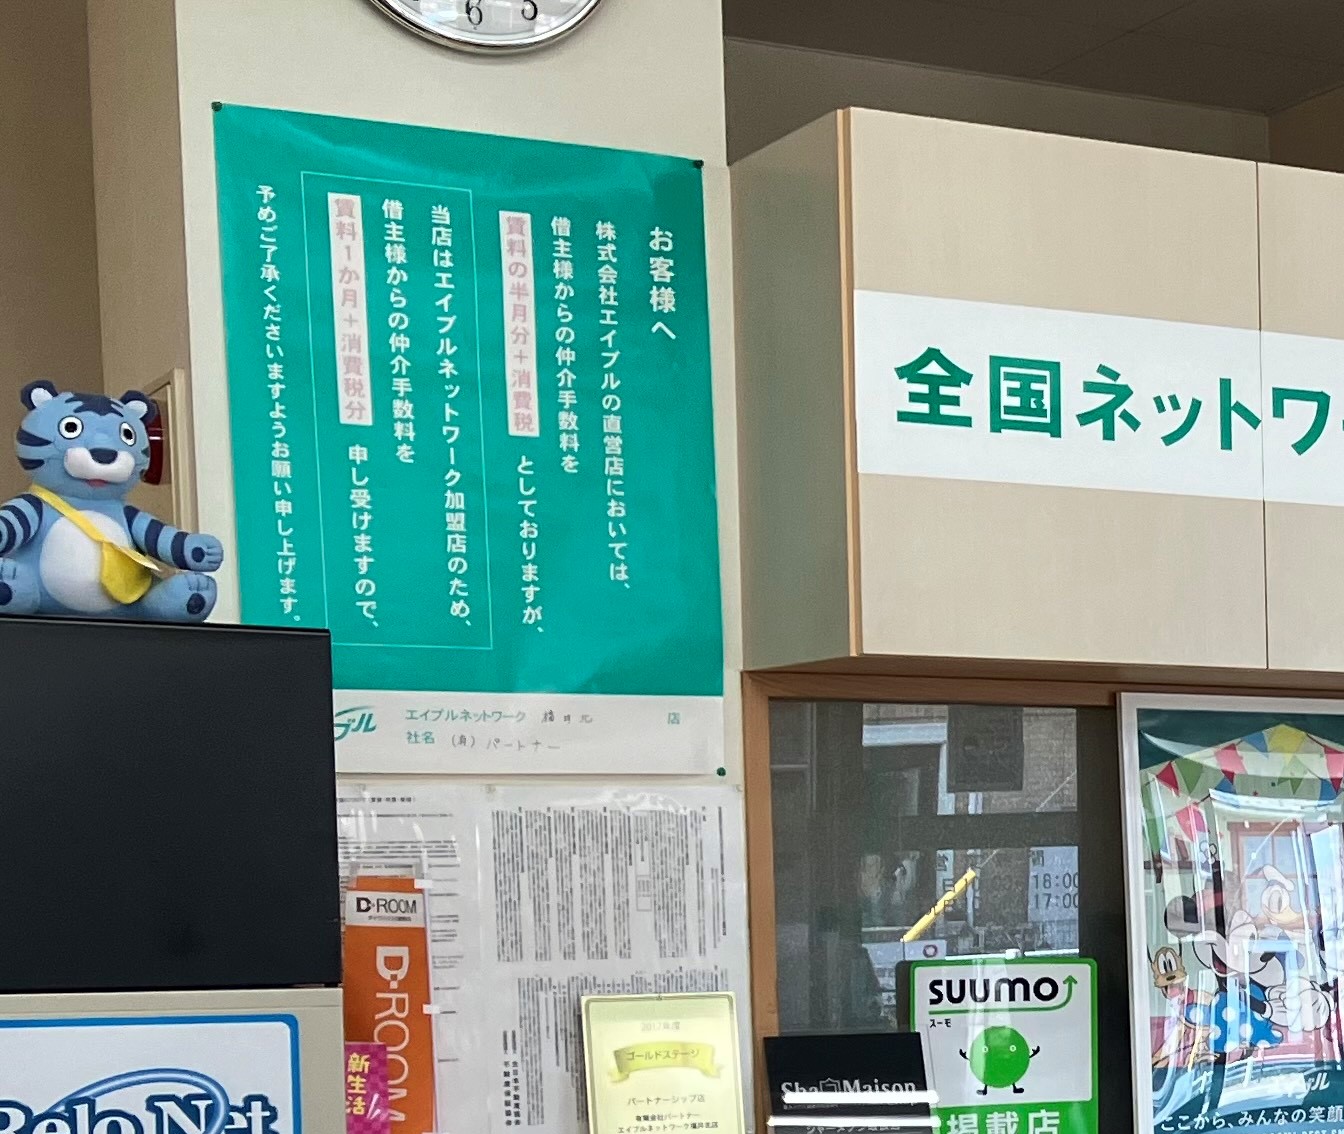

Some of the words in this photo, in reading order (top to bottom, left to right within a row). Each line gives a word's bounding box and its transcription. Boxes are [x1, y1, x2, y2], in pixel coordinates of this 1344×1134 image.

[382, 198, 415, 464] 借主様からの仲介手数料を
[550, 216, 581, 474] 借主様からの仲介手数料を
[648, 227, 677, 340] お客様へ
[255, 184, 302, 624] 予めご了承くださいますようお願い申し上げます。
[431, 204, 472, 628] 当店はエイブルネットワーク加盟店のため、
[595, 221, 631, 590] 株式会社エイブルの直営店においては、
[347, 444, 380, 629] 申し受けますので、
[516, 457, 545, 634] としておりますが、
[405, 708, 526, 723] エイブルネットワーク
[407, 731, 435, 744] 社名
[667, 711, 681, 725] 店
[627, 1048, 700, 1061] ゴールドステージ
[929, 1018, 952, 1028] スーモ
